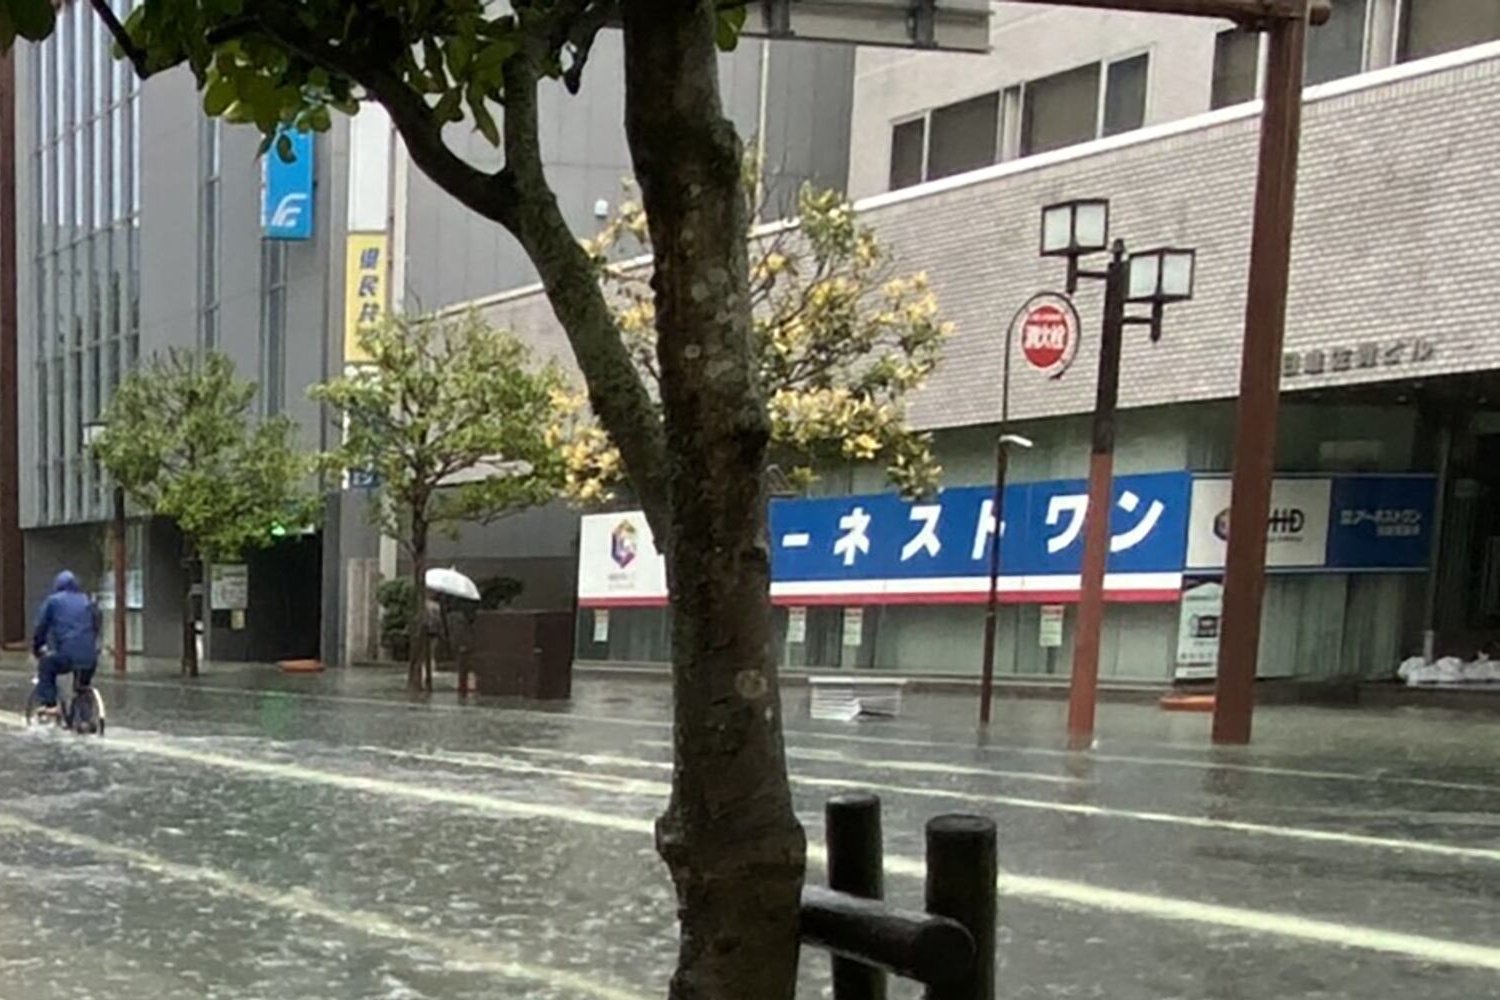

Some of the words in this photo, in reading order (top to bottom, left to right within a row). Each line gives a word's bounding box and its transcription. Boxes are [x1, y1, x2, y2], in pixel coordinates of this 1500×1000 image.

[358, 247, 380, 324] 県民共
[1024, 323, 1067, 350] 消火栓
[782, 490, 1164, 566] ーネストワン
